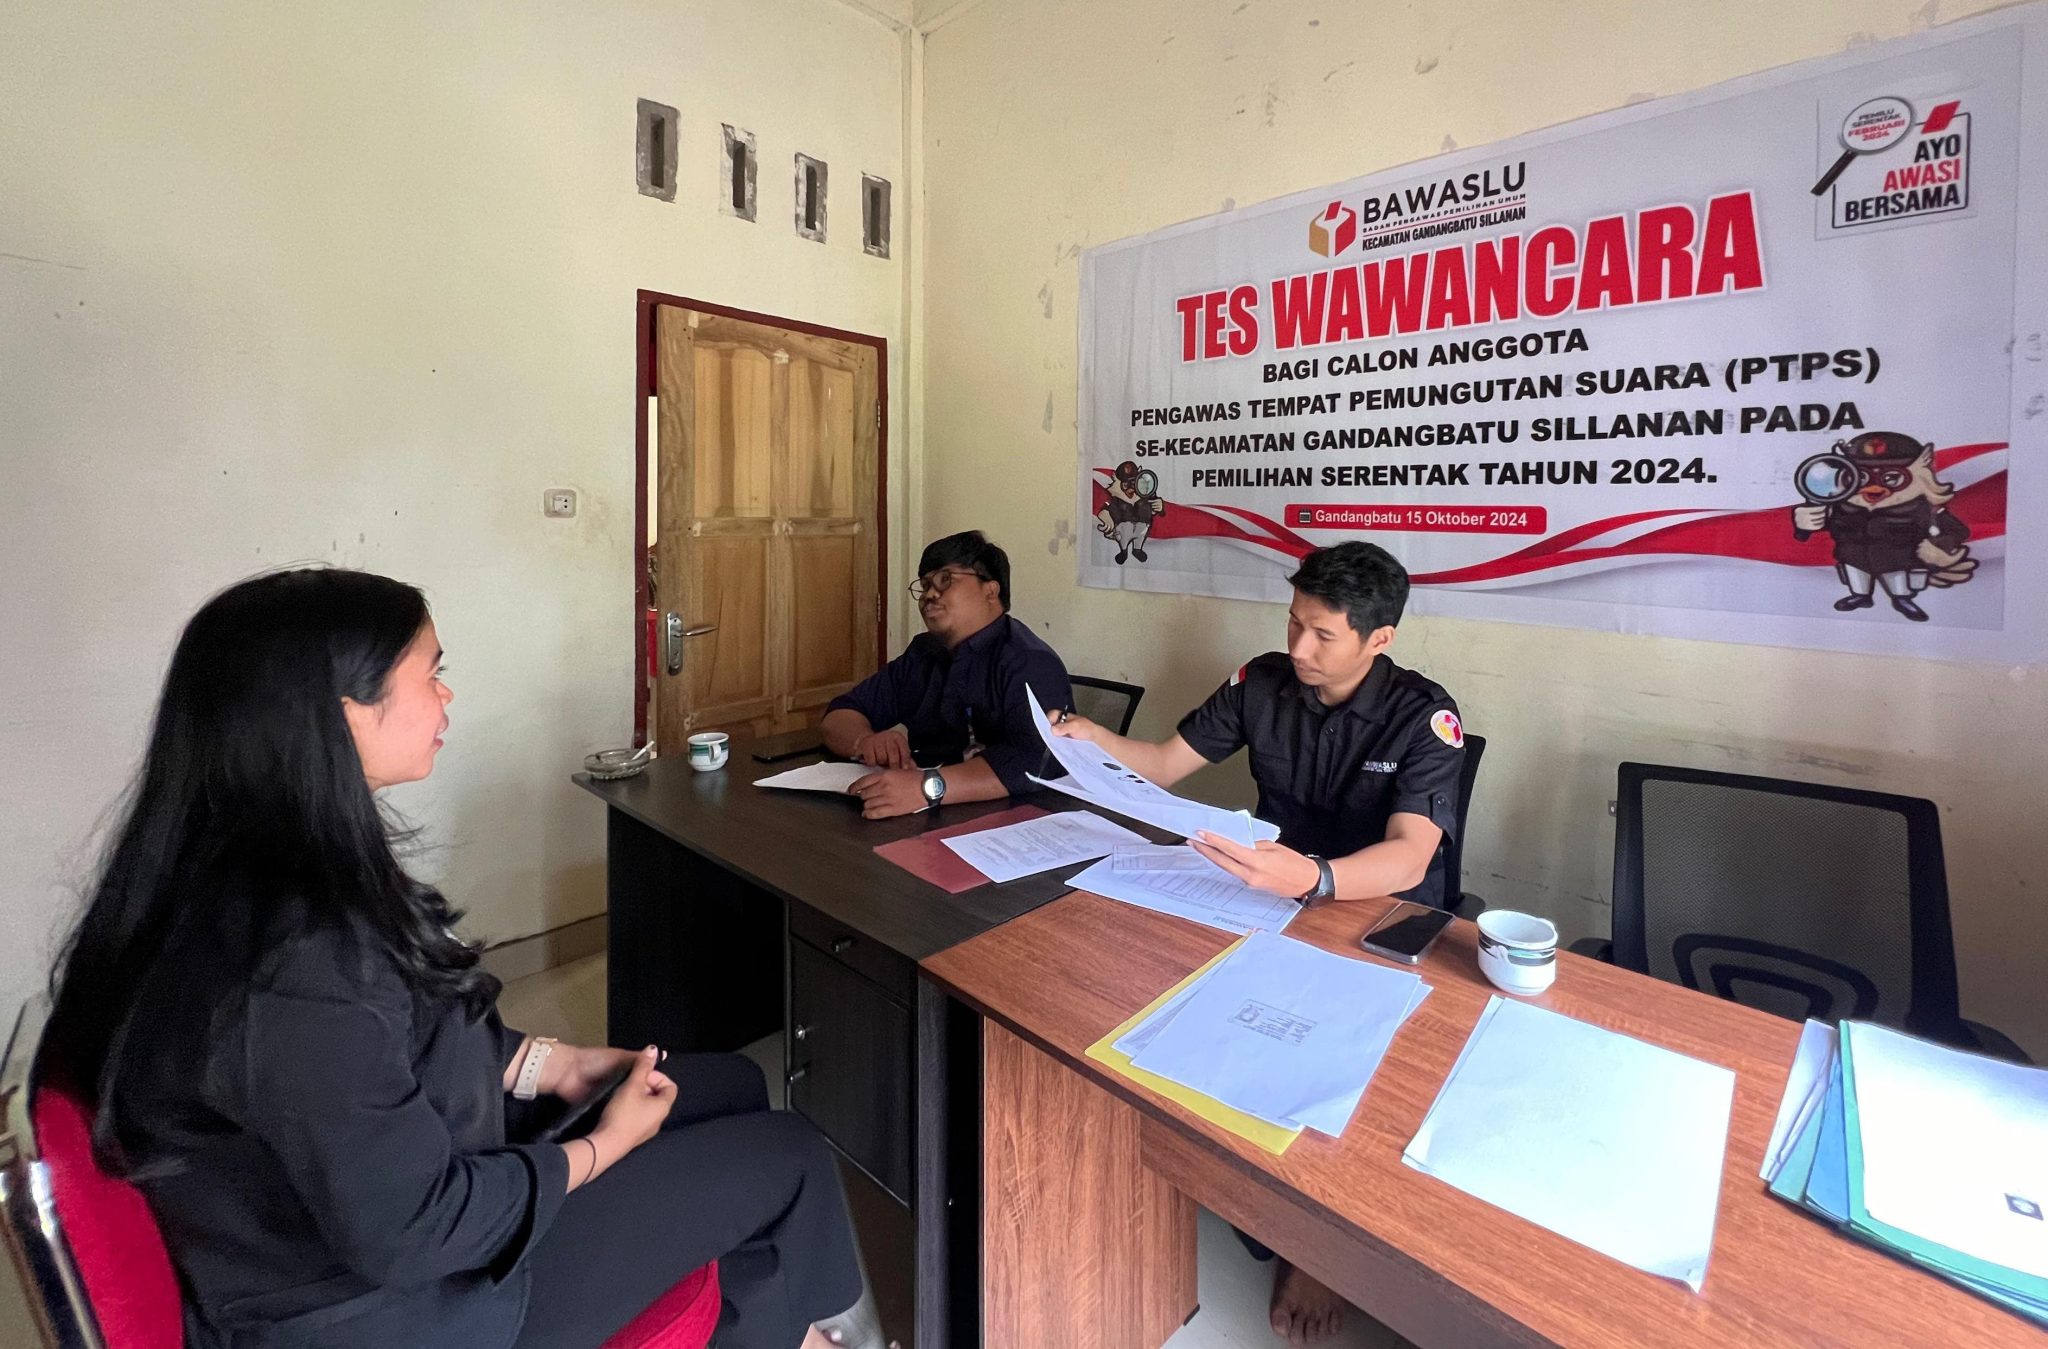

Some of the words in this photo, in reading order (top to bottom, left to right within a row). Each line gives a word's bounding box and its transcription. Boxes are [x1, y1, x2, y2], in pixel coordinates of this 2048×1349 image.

[1852, 113, 1902, 128] SERENTAK
[1858, 108, 1895, 121] PEMILU
[1862, 131, 1891, 142] 2024
[1914, 133, 1961, 163] AYO
[1363, 161, 1526, 224] BAWASLU
[1883, 158, 1961, 193] AWASI
[1362, 222, 1391, 233] BADAN
[1392, 211, 1441, 227] PENGAWAS
[1443, 200, 1495, 217] PEMILIHAN
[1498, 193, 1526, 206] UMUM
[1844, 183, 1961, 222] BERSAMA
[1362, 232, 1410, 251] KECAMATAN
[1412, 216, 1477, 241] GANDANGBATU
[1479, 206, 1526, 228] SILLANAN
[1176, 284, 1259, 363] TES
[1270, 191, 1764, 351] WAWANCARA
[1263, 359, 1318, 383] BAGI
[1327, 347, 1418, 377] CALON
[1428, 328, 1589, 367] ANGGOTA
[1131, 401, 1241, 427] PENGAWAS
[1248, 393, 1341, 418] TEMPAT
[1350, 374, 1563, 412] PEMUNGUTAN
[1575, 362, 1710, 397] SUARA
[1725, 347, 1881, 392] (PTPS)
[1135, 432, 1295, 457] SE-KECAMATAN
[1303, 420, 1519, 451] GANDANGBATU
[1530, 408, 1724, 442] SILLANAN
[1740, 402, 1865, 434] PADA
[1192, 467, 1313, 488] PEMILIHAN
[1321, 463, 1470, 487] SERENTAK
[1479, 460, 1598, 485] TAHUN
[1610, 458, 1718, 484] 2024.
[1315, 509, 1402, 527] Gandangbatu
[1406, 510, 1422, 525] 15
[1425, 511, 1486, 526] Oktober
[1489, 512, 1528, 527] 2024
